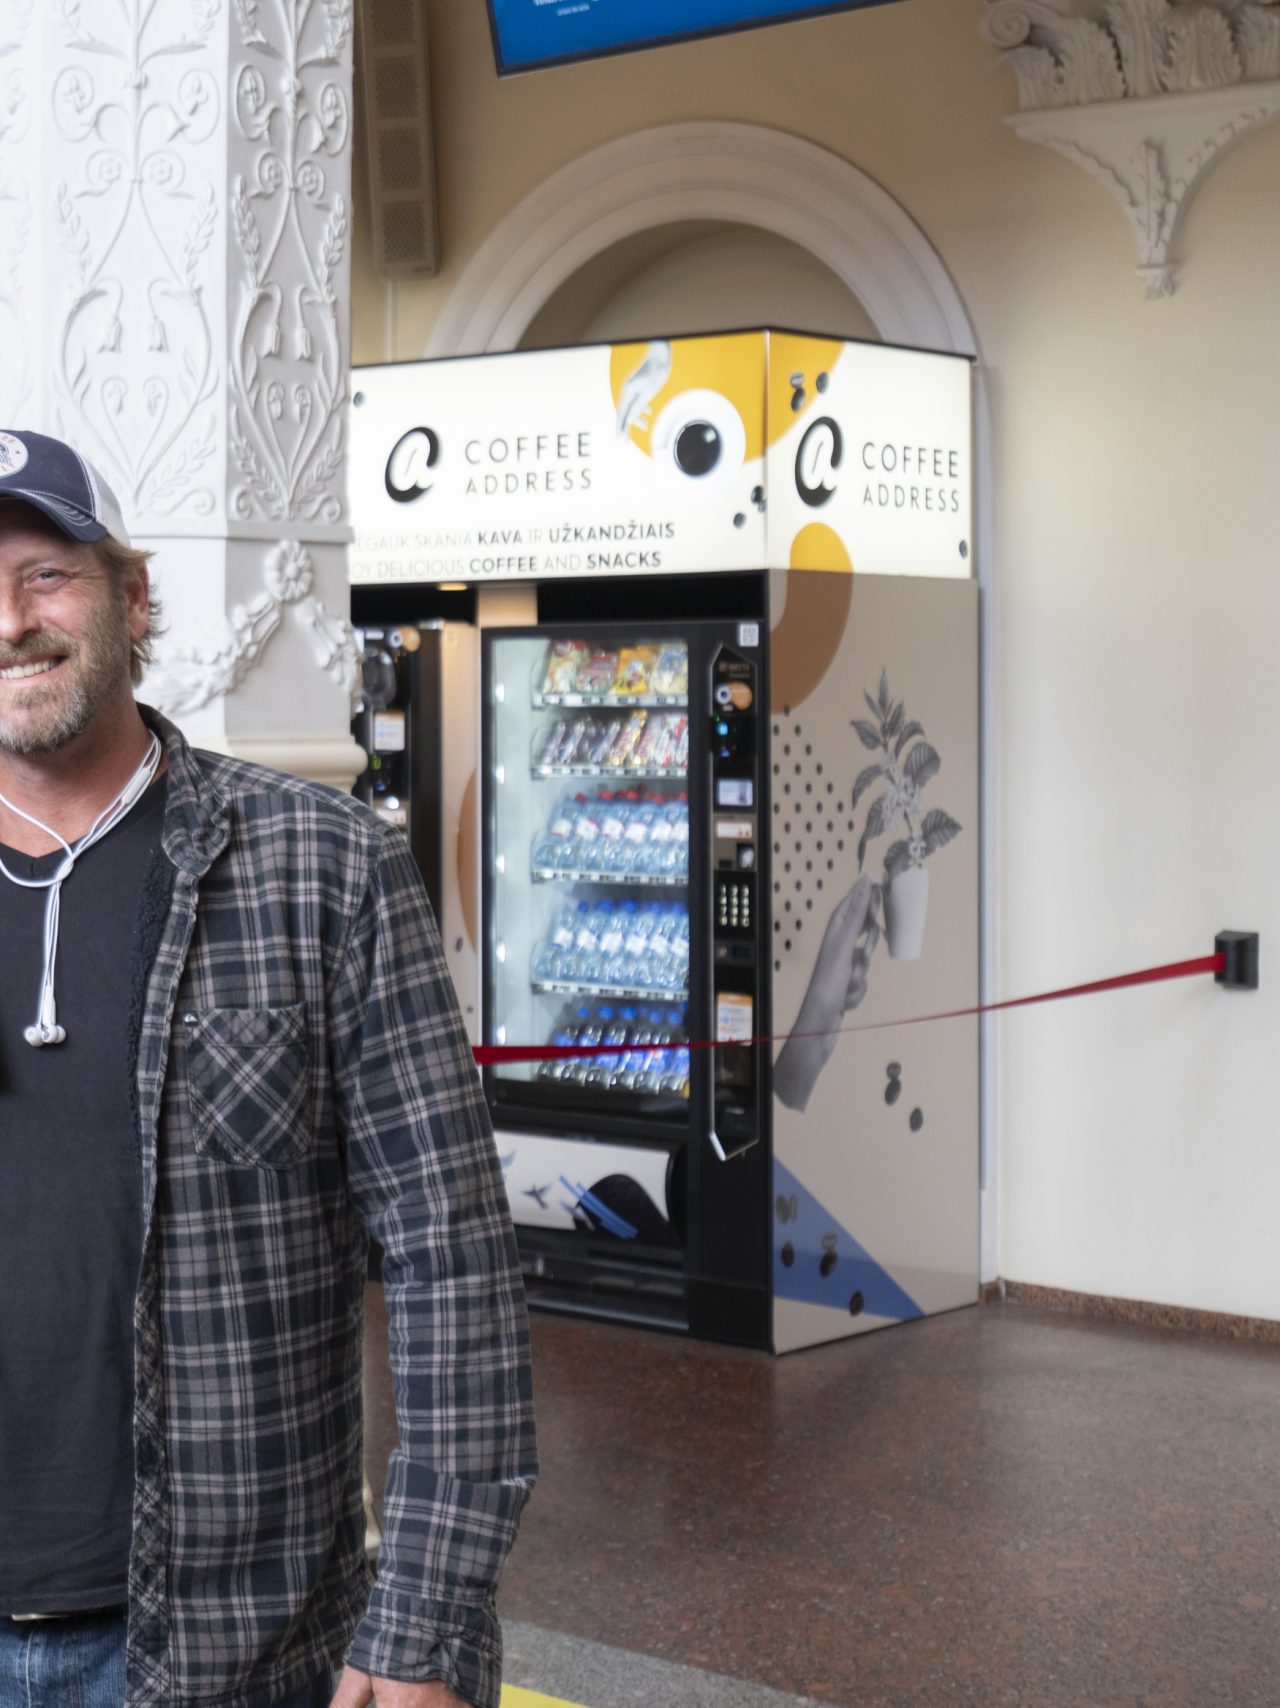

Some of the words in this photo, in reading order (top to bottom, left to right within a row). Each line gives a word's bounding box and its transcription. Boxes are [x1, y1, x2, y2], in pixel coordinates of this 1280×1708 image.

[464, 432, 591, 464] COFFEE
[862, 442, 959, 477] COFFEE
[465, 468, 592, 495] ADDRESS
[862, 483, 960, 512] ADDRESS
[478, 529, 523, 546] KAVA
[528, 528, 544, 544] IR
[549, 519, 676, 544] UŽKANDŽIAIS
[376, 558, 465, 578] DELICIOUS
[470, 555, 538, 574] COFFEE
[544, 554, 581, 571] AND
[587, 551, 662, 570] SNACKS
